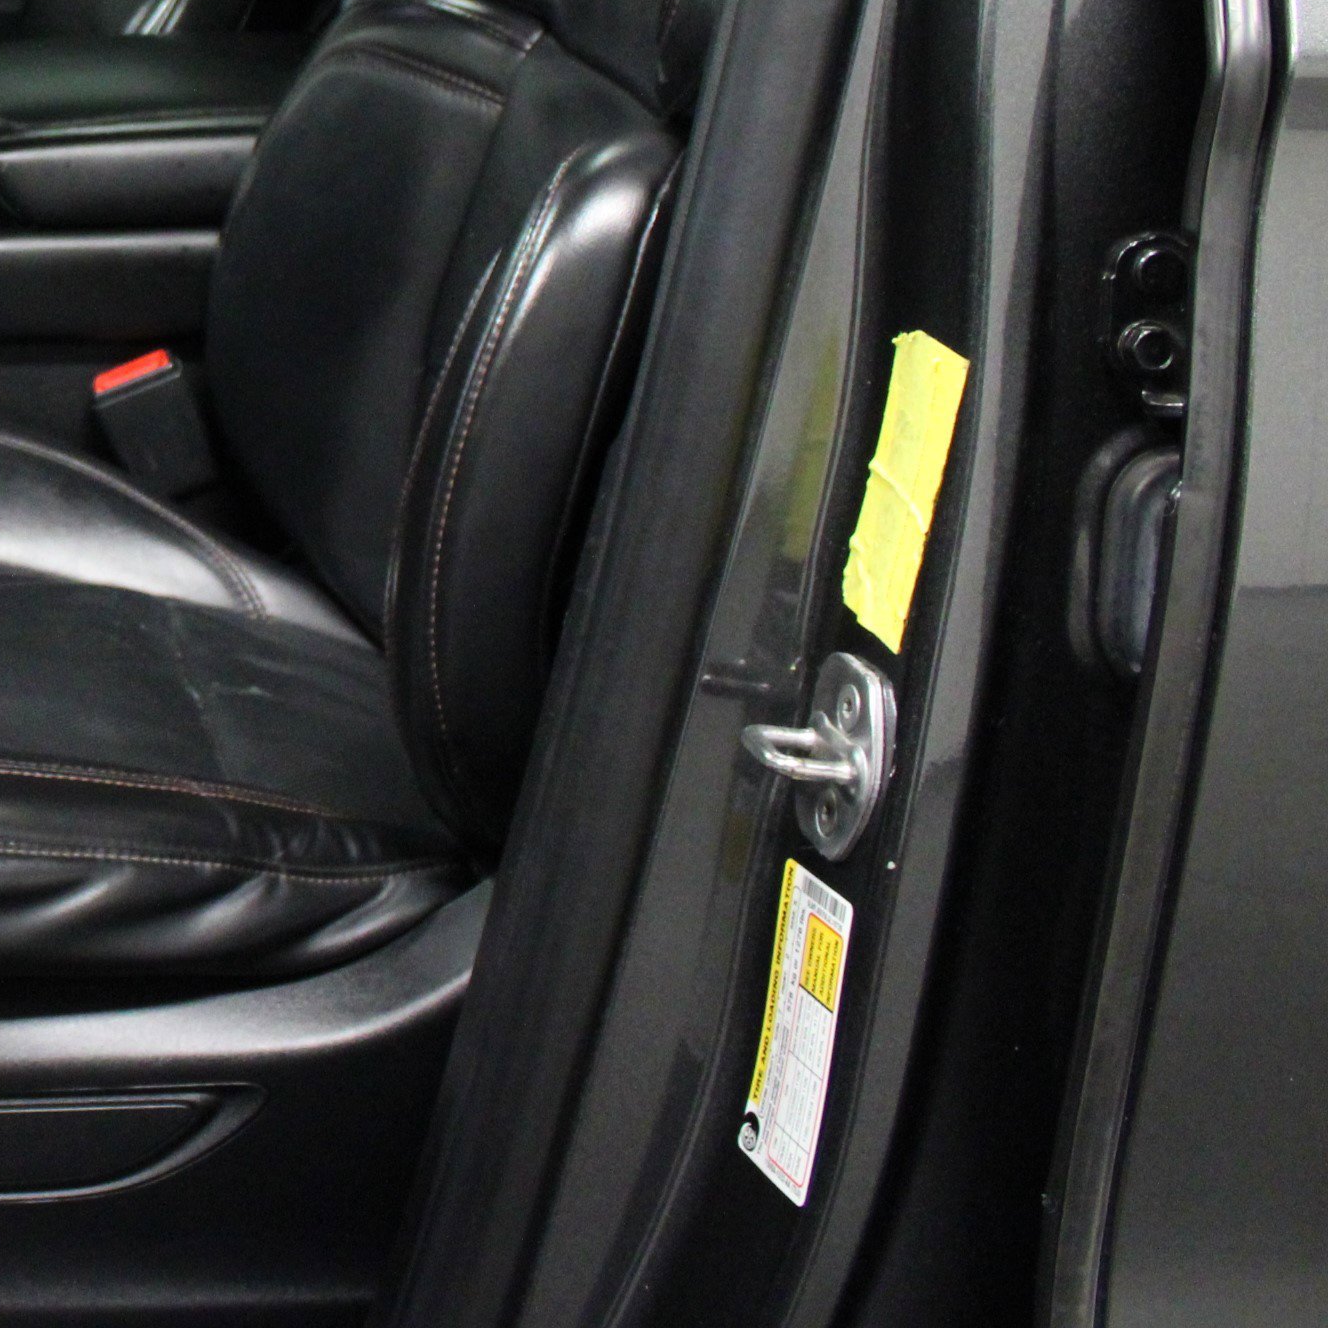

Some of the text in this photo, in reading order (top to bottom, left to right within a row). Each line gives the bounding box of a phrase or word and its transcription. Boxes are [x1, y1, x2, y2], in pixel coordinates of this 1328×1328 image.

[752, 1070, 762, 1100] TIRE
[760, 1035, 769, 1065] AND
[766, 969, 779, 1032] LOADING
[776, 866, 794, 965] INFORMATION
